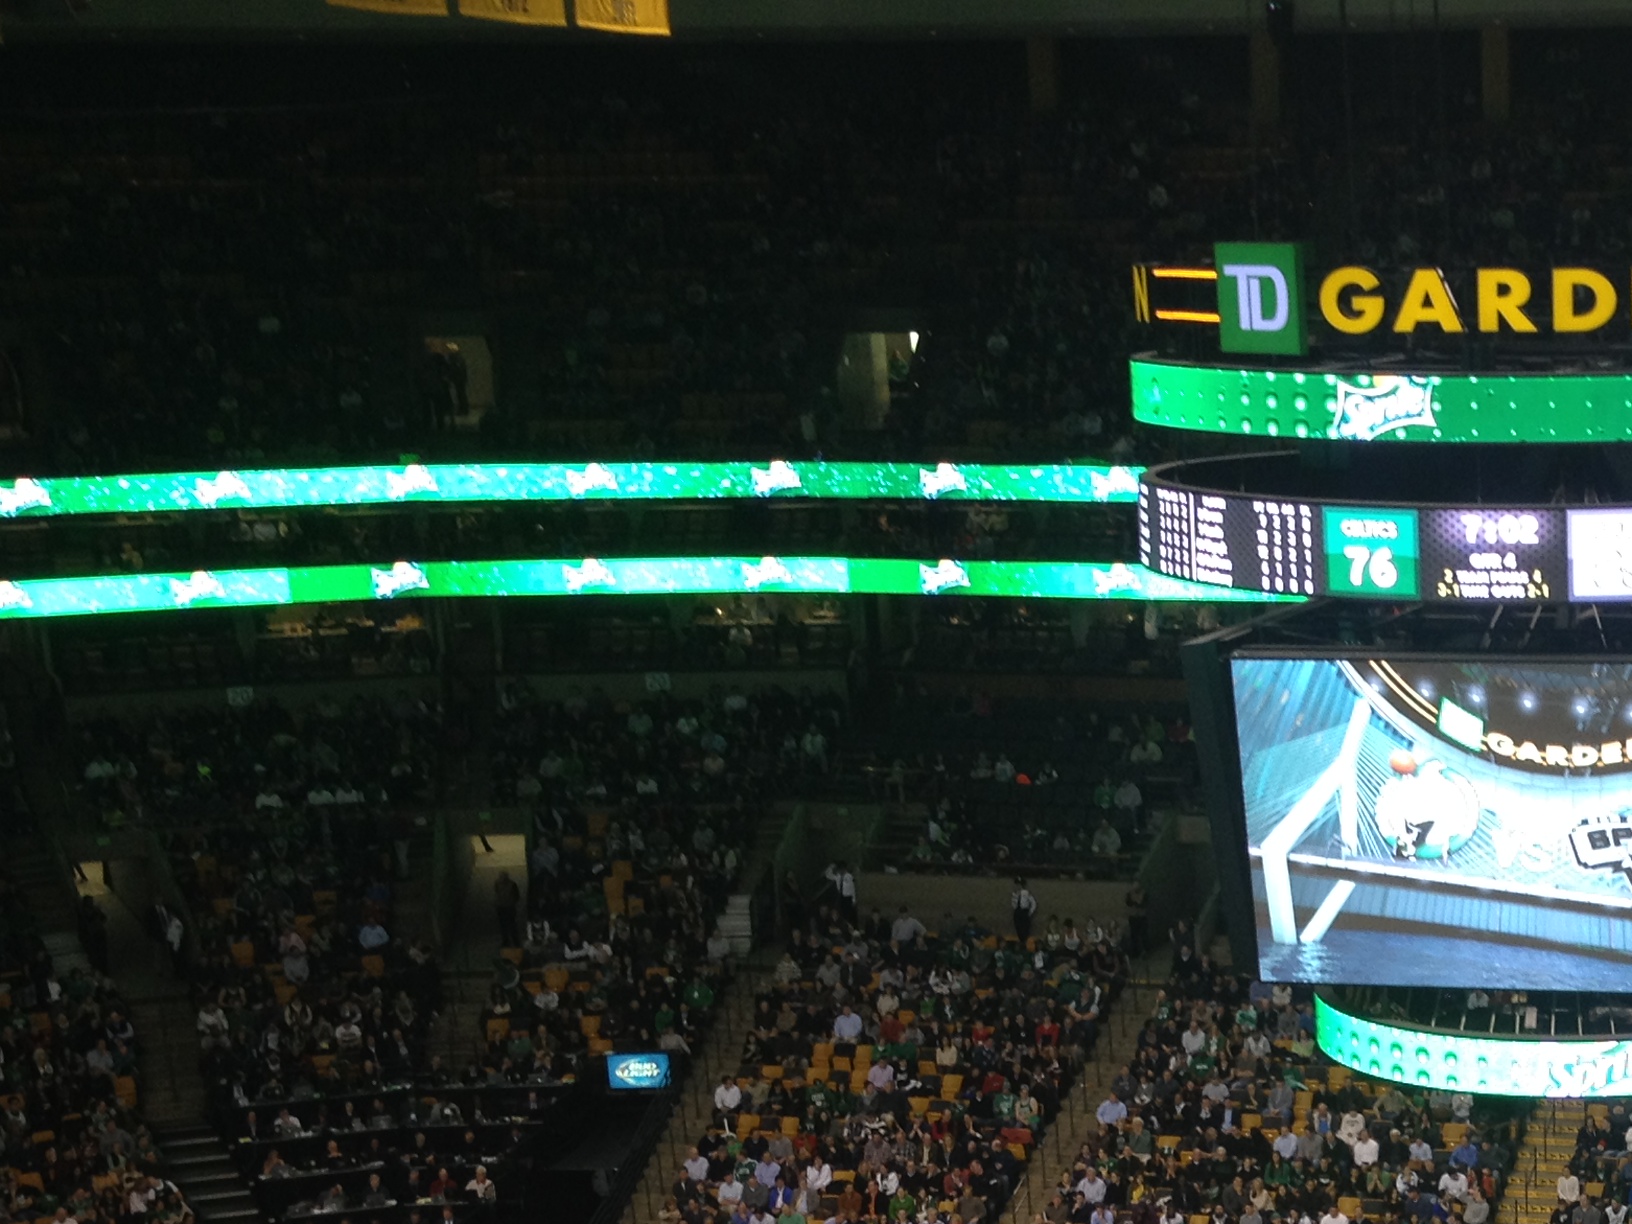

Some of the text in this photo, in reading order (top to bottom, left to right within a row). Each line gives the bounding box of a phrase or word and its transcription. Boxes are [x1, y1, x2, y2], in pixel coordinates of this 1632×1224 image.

[1223, 264, 1289, 331] TD
[1460, 514, 1540, 544] 7:02
[1343, 545, 1398, 588] 76
